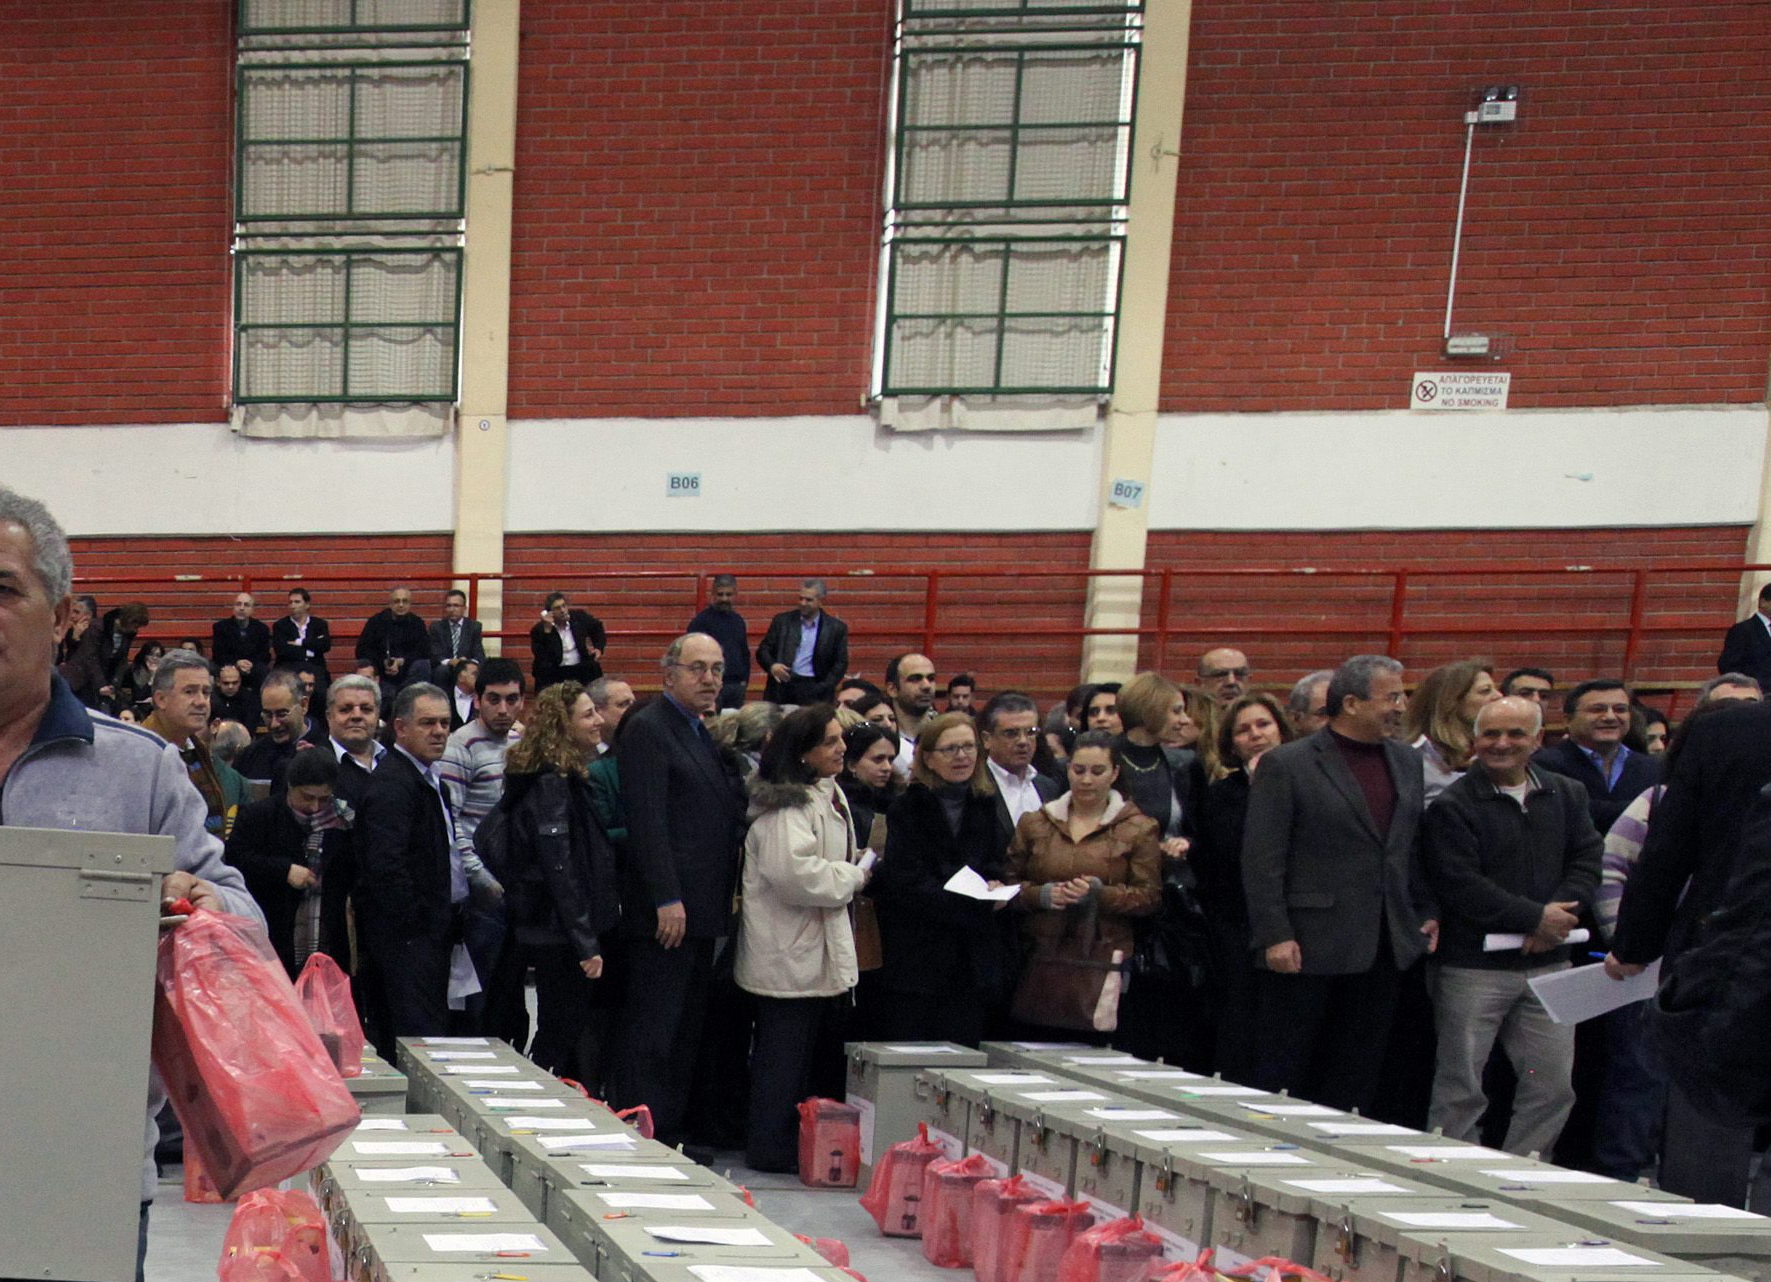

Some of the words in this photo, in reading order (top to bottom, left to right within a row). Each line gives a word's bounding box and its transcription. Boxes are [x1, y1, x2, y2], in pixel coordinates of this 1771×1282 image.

[1441, 398, 1454, 406] NO
[1457, 398, 1499, 406] SMOKING
[671, 476, 699, 489] B06
[1114, 482, 1142, 499] B07
